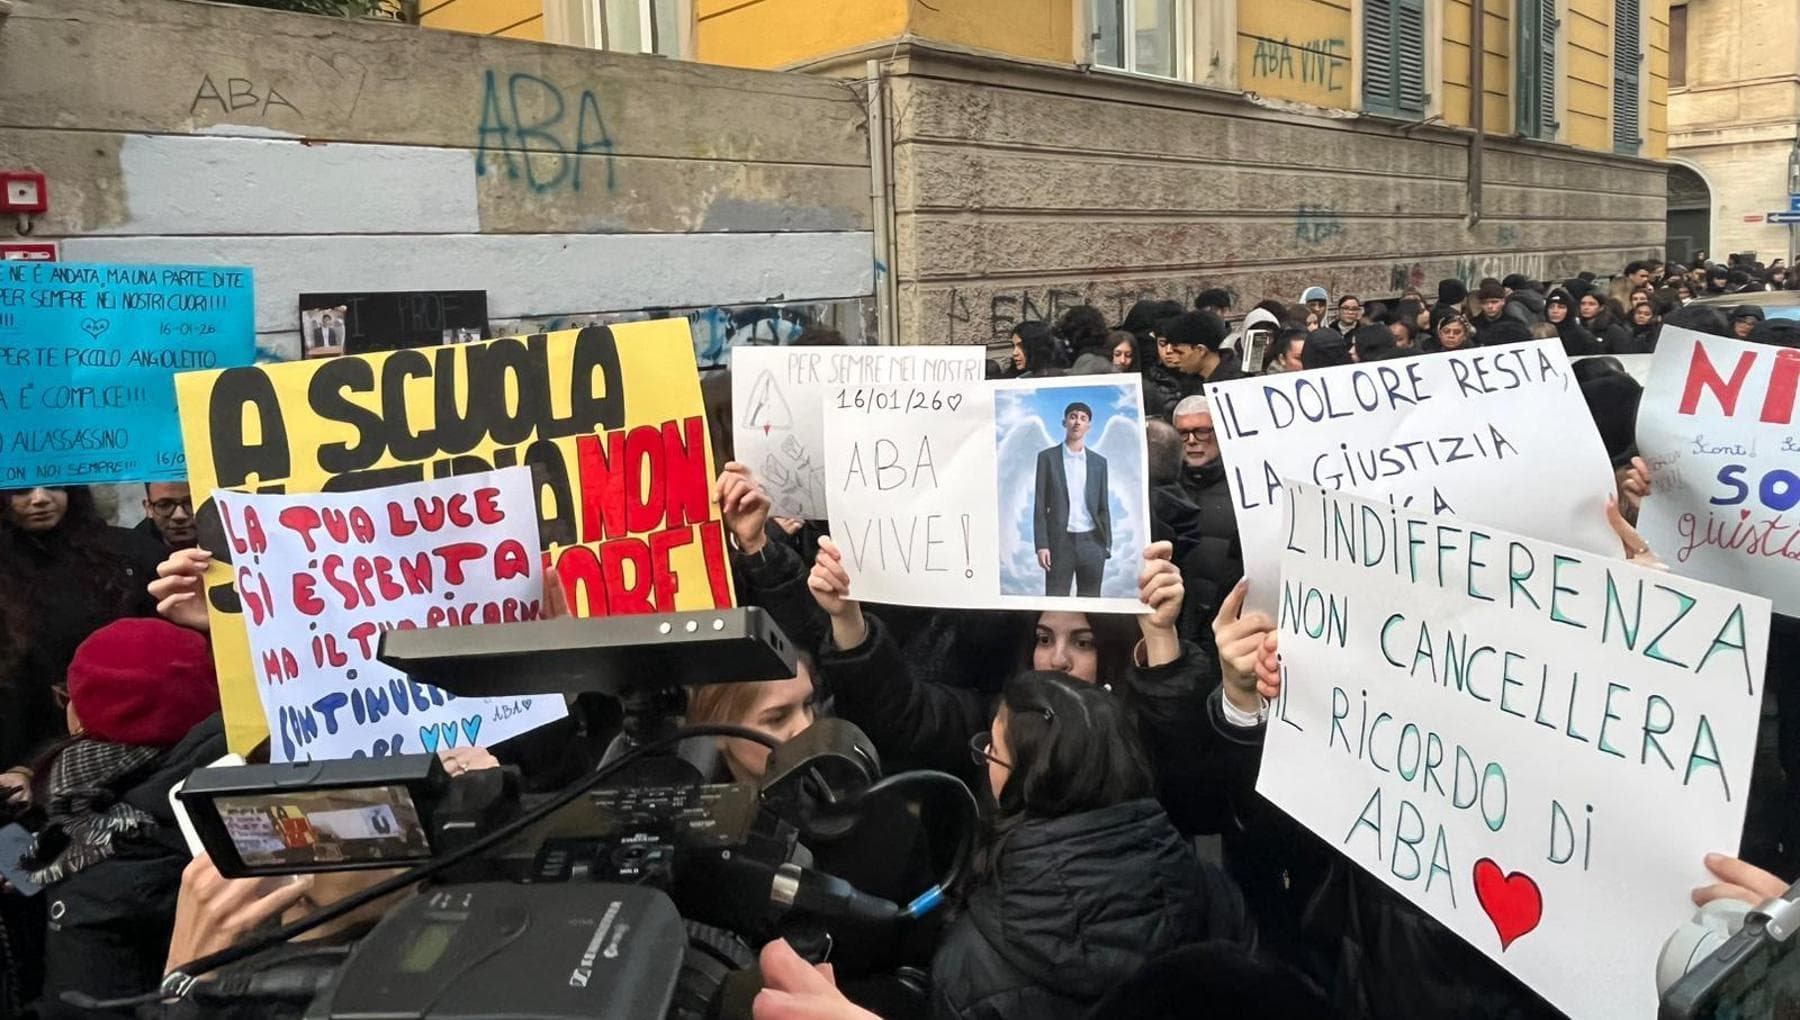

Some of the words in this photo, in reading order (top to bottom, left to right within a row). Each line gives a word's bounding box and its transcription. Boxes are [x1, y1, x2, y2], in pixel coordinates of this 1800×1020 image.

[1253, 37, 1294, 79] ABA
[1300, 37, 1345, 92] VIVE
[190, 73, 304, 120] ABA
[475, 69, 615, 195] ABA
[31, 289, 88, 310] SEMPRE
[97, 291, 117, 310] NEI
[122, 291, 165, 312] NOSTRI
[162, 268, 210, 288] PARTE
[35, 347, 58, 368] TE
[65, 347, 120, 368] PICCOLO
[787, 352, 822, 384] PER
[827, 353, 885, 384] SEMRE
[889, 354, 916, 382] NEI
[922, 357, 983, 384] NOSTRI
[208, 366, 291, 488] A
[308, 325, 626, 475] SCUOLA
[836, 387, 943, 414] 16/01/26
[1262, 361, 1433, 430] DOLORE
[1448, 347, 1571, 398] RESTA,
[575, 414, 714, 545] NON
[843, 434, 939, 493] ABA
[1234, 459, 1286, 511] LA
[219, 499, 267, 555] LA
[278, 506, 376, 552] TUA
[386, 487, 505, 537] LUCE
[842, 514, 975, 579] VIVE!
[322, 538, 531, 612] SPENTA
[262, 647, 299, 686] MA
[1280, 580, 1349, 649] NON
[1379, 612, 1732, 803] CANCELLERA
[492, 701, 524, 724] ABA
[1343, 786, 1458, 910] ABA
